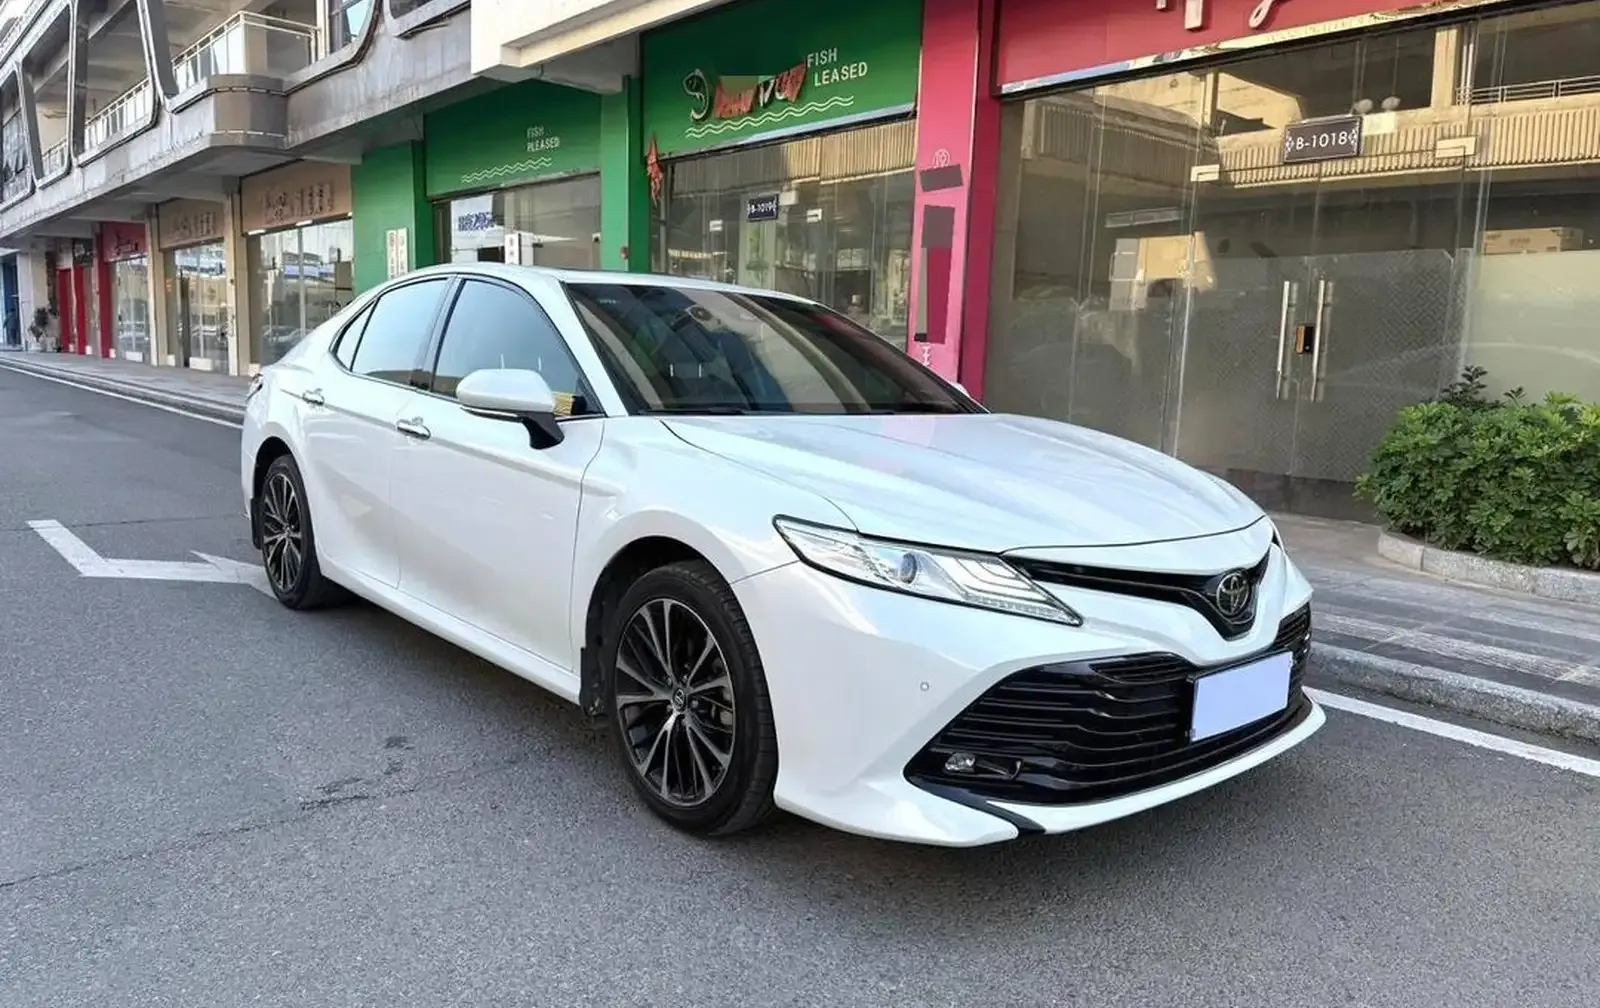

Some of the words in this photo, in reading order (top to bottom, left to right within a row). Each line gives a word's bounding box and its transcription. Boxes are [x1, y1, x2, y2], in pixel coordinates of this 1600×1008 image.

[807, 47, 837, 68] FISH
[814, 61, 868, 87] LEASED
[526, 126, 545, 139] FISH
[526, 136, 560, 152] PLEASED
